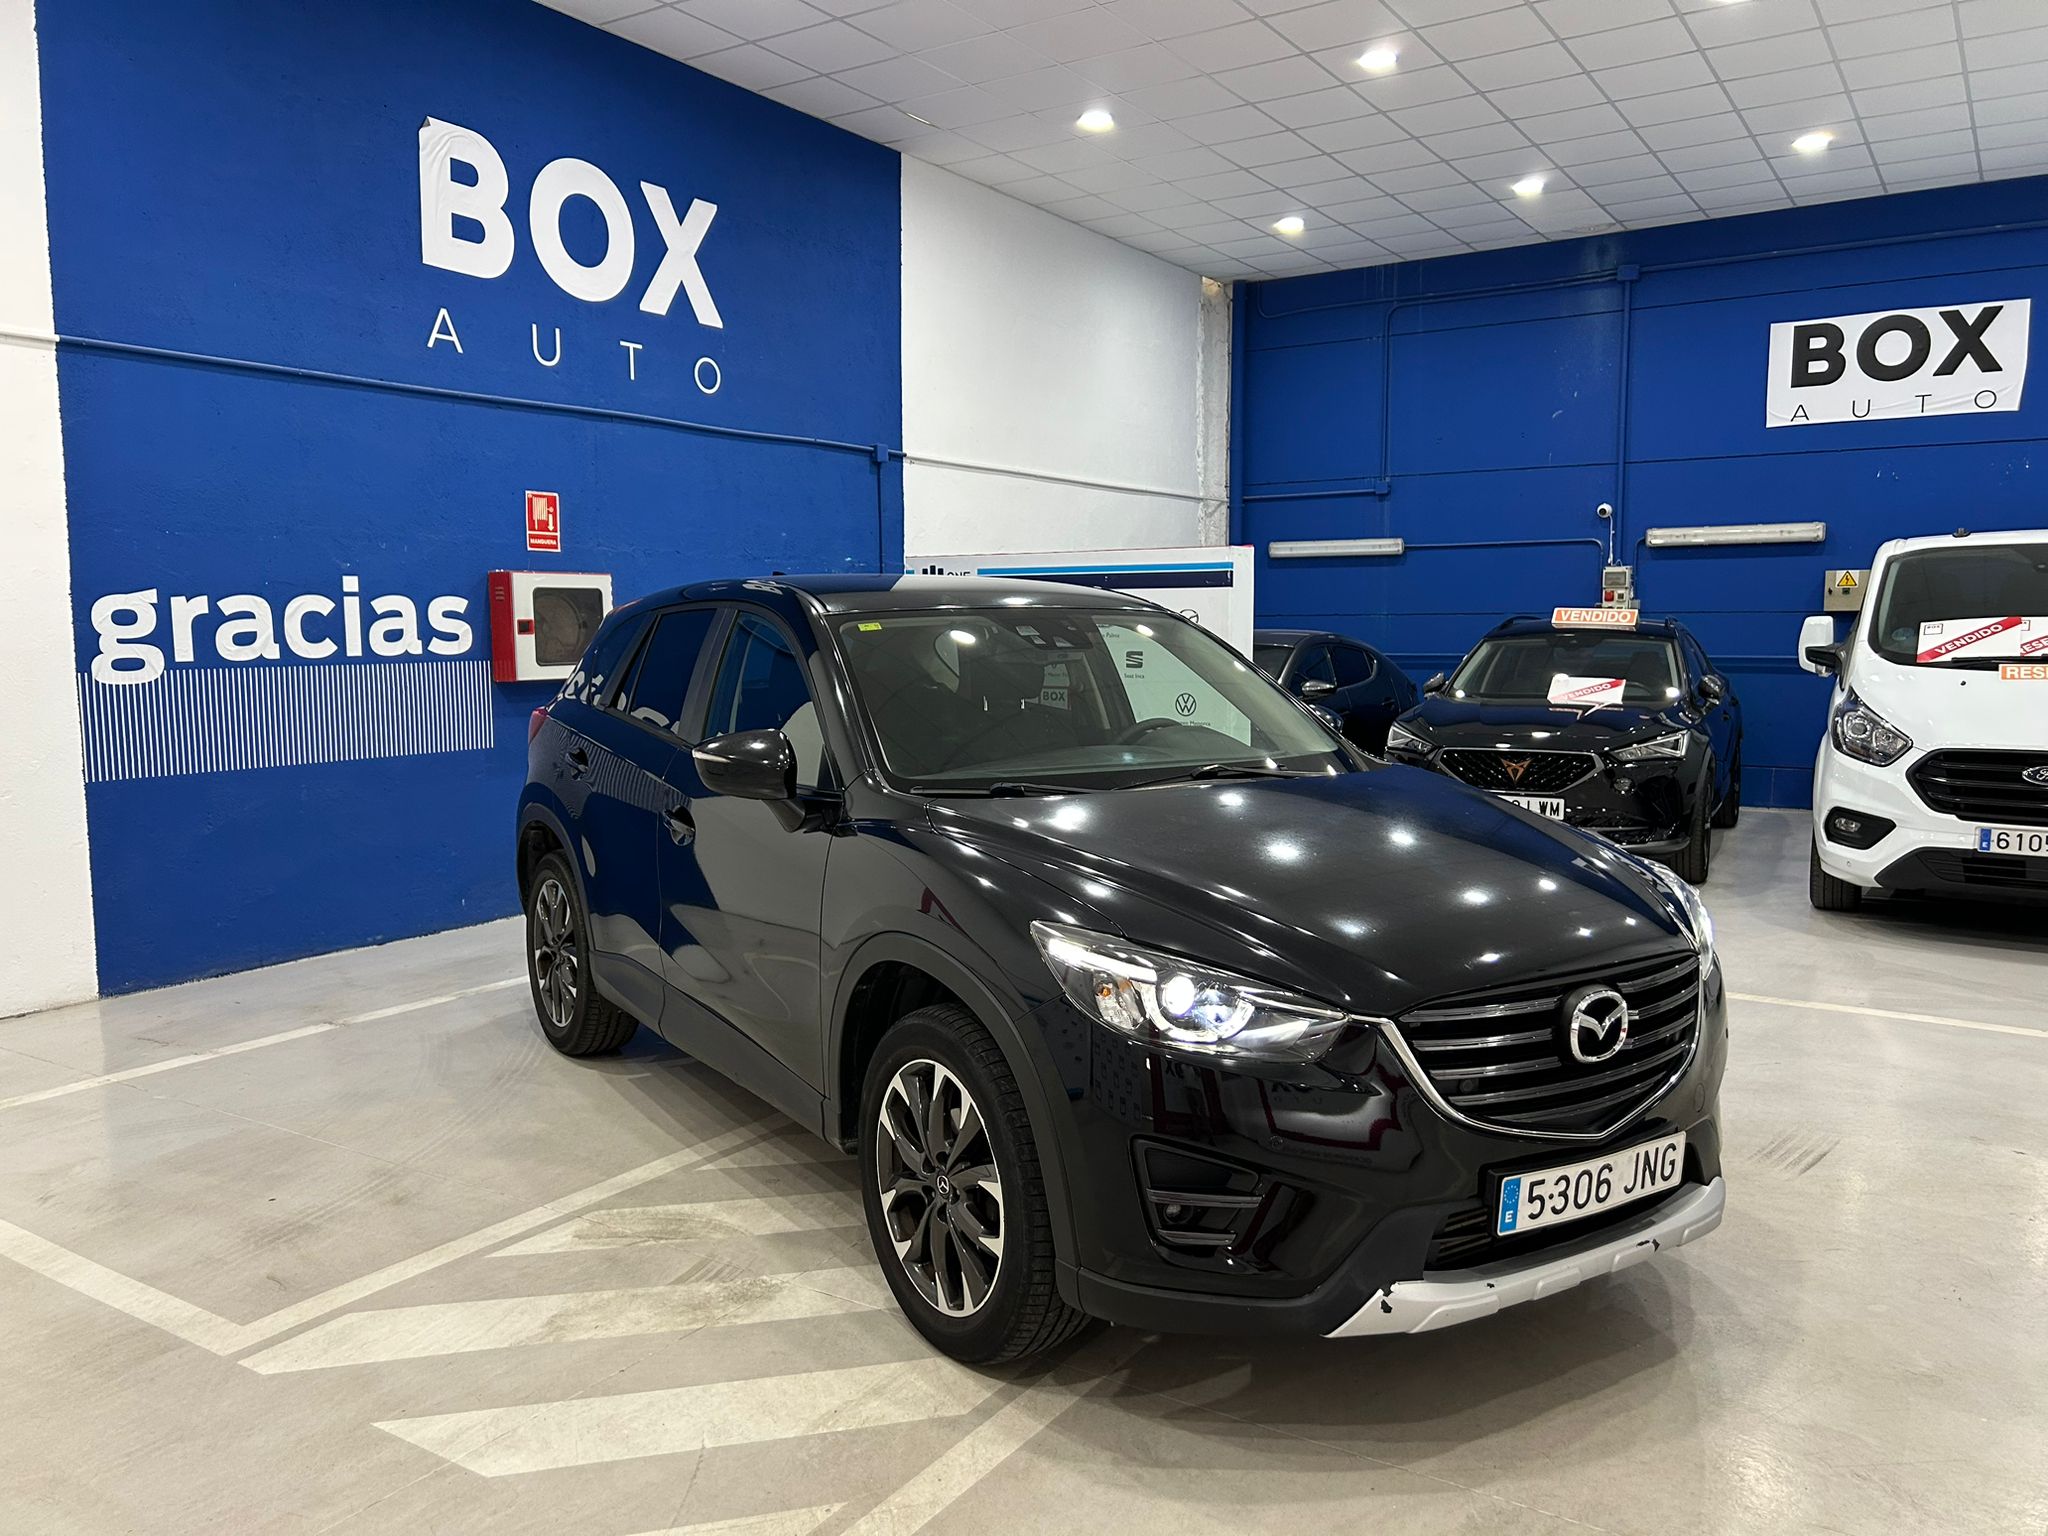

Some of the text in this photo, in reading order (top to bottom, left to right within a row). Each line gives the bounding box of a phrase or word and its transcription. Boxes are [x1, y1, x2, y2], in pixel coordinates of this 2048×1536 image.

[419, 116, 723, 329] BOX
[428, 307, 723, 395] AUTO
[1791, 305, 2004, 388] BOX
[1790, 390, 1998, 422] AUTO
[91, 575, 473, 685] gracias
[1561, 610, 1631, 623] VENDIDO
[1934, 624, 2004, 654] VENDIDO
[2006, 667, 2048, 679] RES
[1043, 691, 1066, 701] BOX
[1563, 682, 1611, 699] VENDIDO
[1997, 832, 2048, 852] 610
[1504, 1143, 1677, 1223] E 5306 JNG
